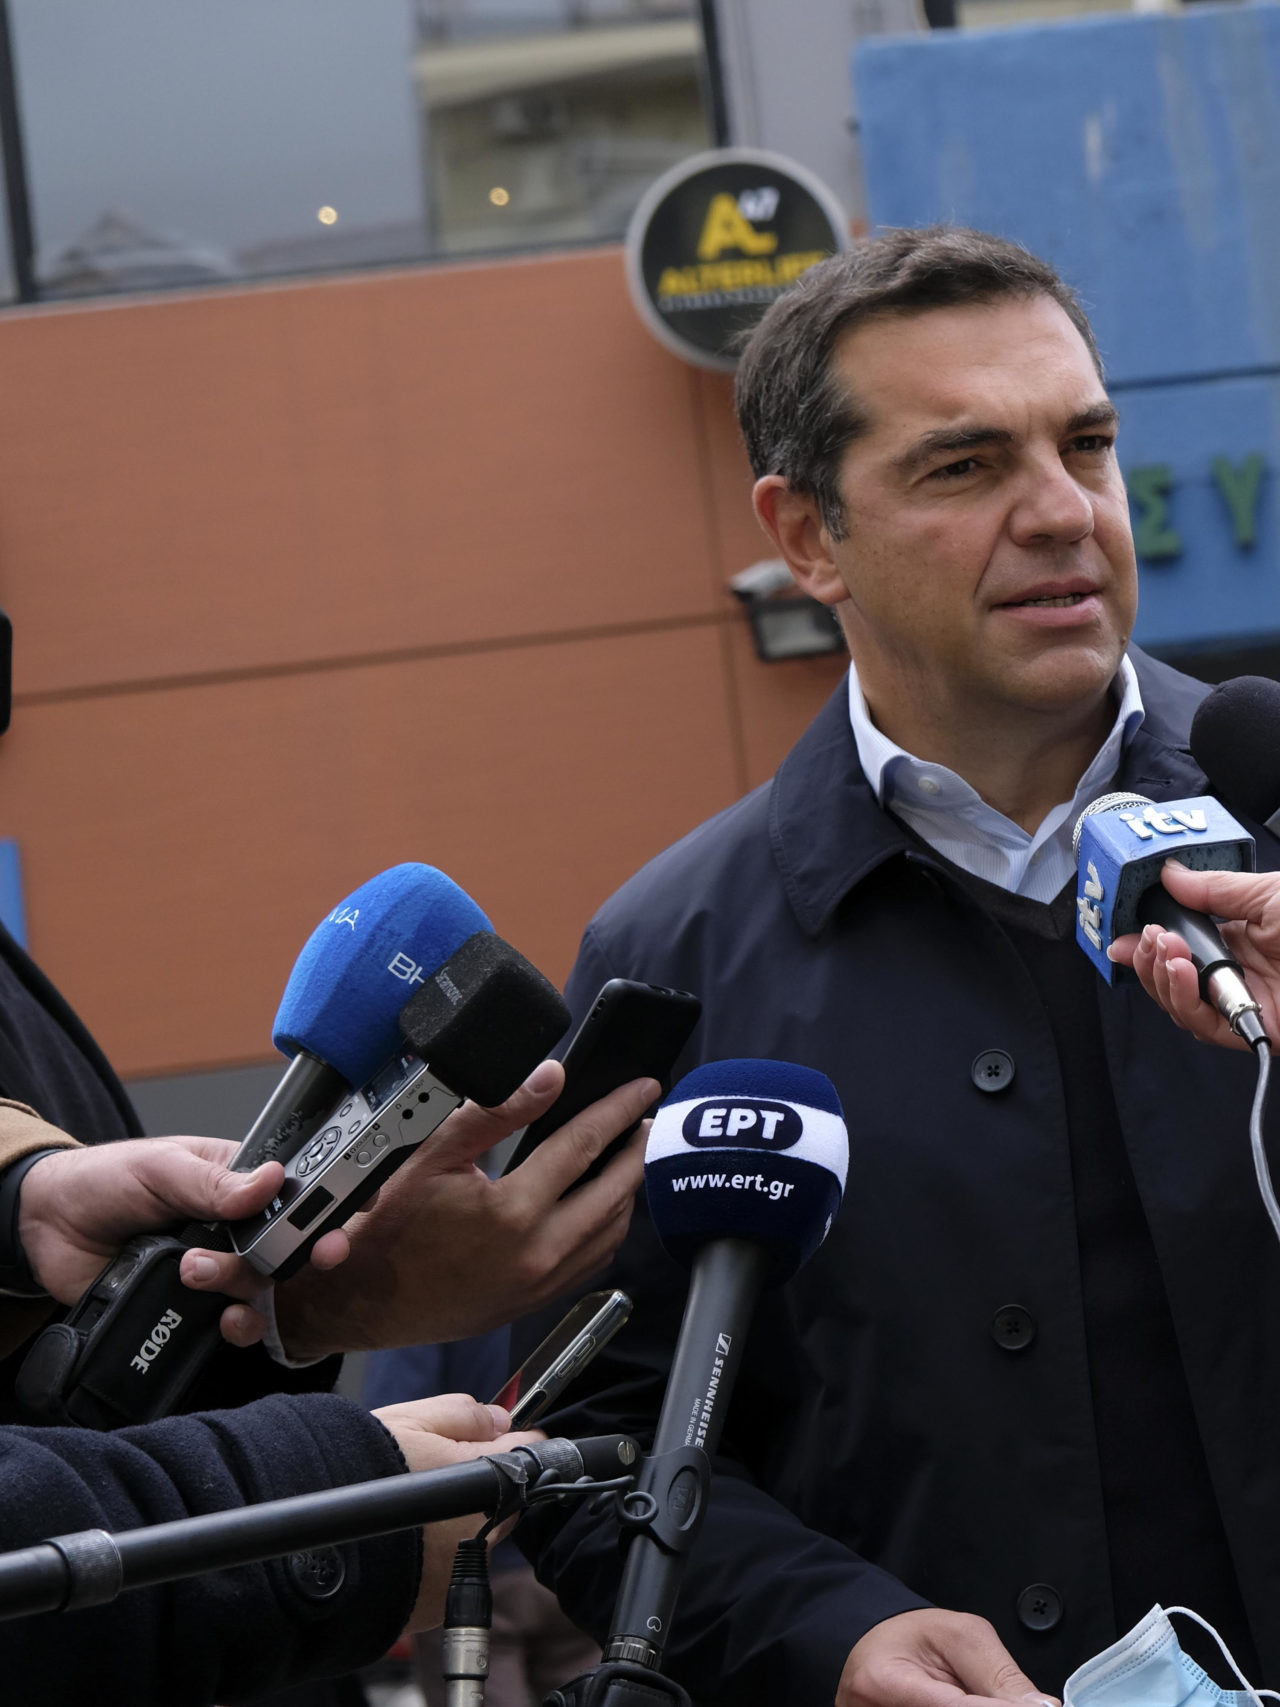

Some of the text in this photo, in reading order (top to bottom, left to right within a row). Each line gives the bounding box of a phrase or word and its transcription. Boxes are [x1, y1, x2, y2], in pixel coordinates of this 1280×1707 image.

[1119, 806, 1208, 840] itv
[1077, 860, 1104, 950] itv
[698, 1107, 785, 1140] ΕΡΤ
[671, 1172, 795, 1201] www.ert.gr
[691, 1397, 702, 1416] MADE
[694, 1356, 724, 1448] SENNHEISE
[689, 1416, 698, 1424] IN
